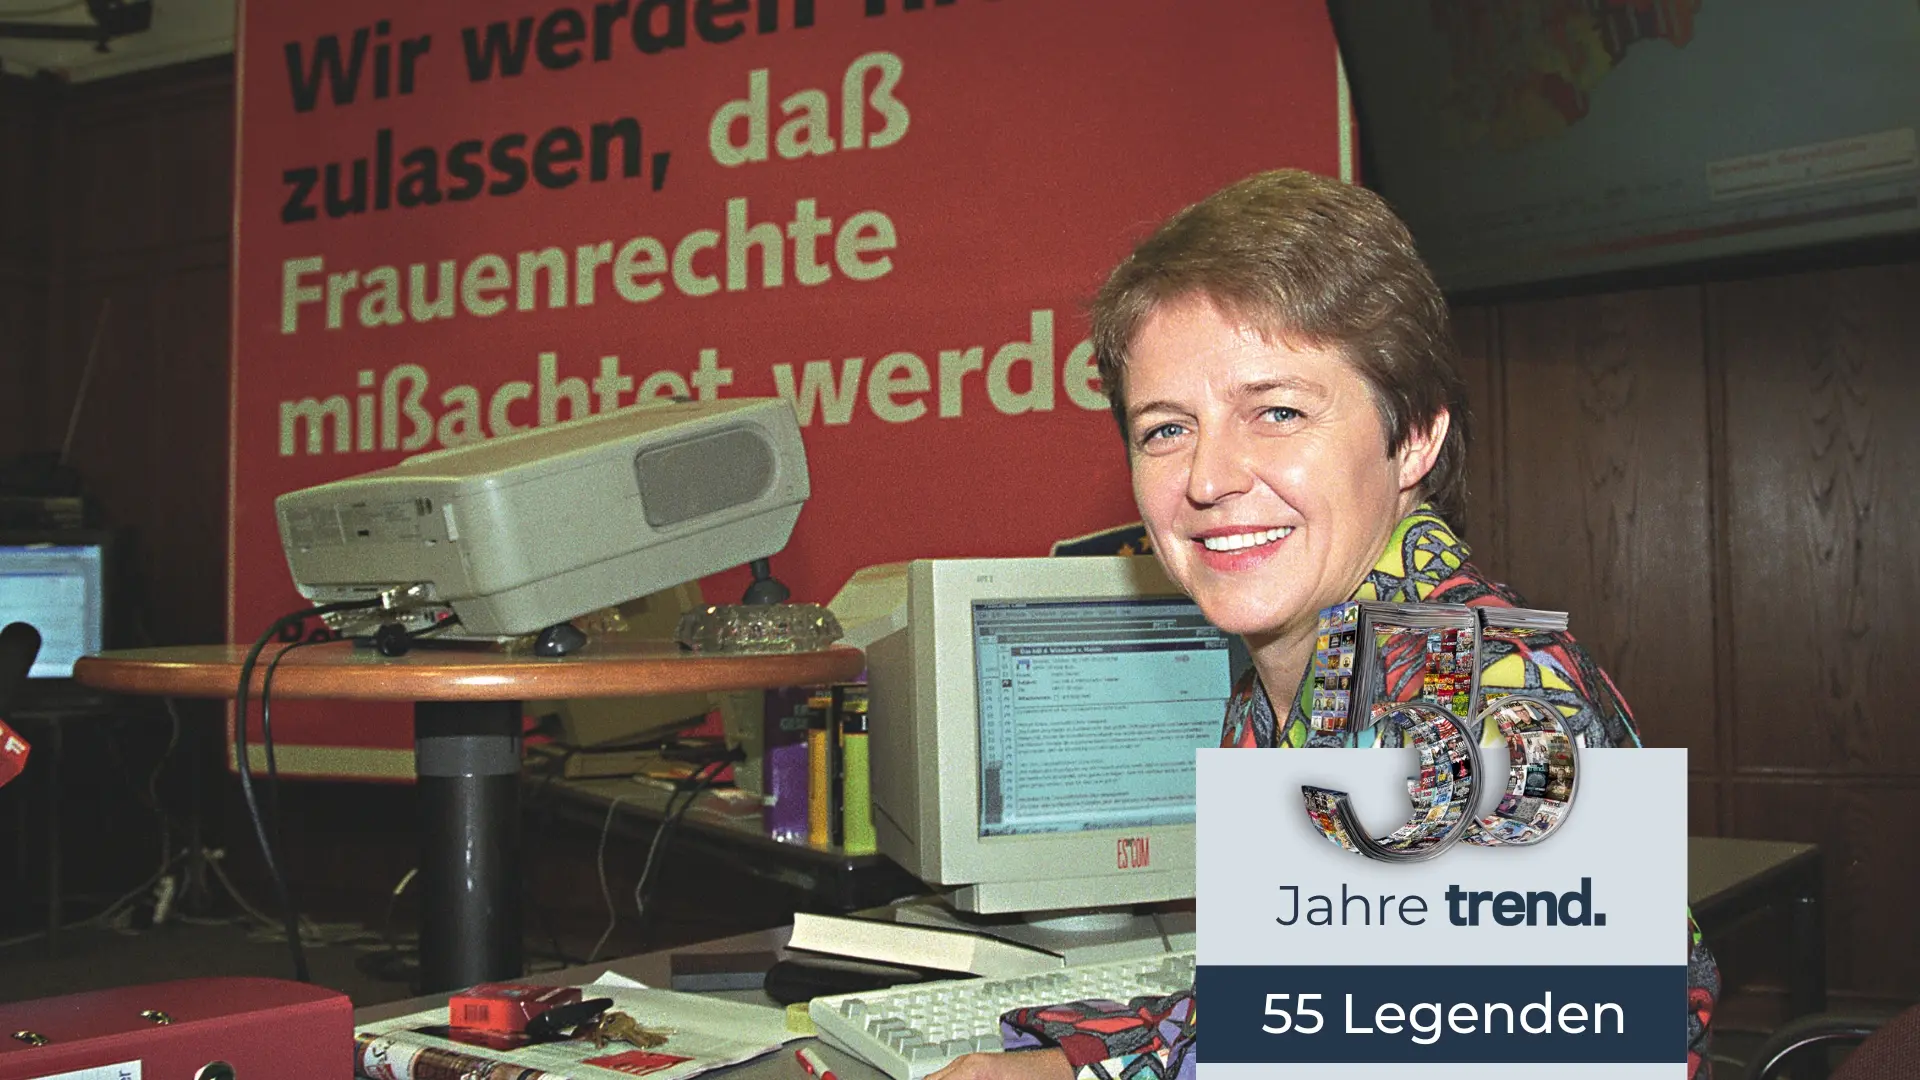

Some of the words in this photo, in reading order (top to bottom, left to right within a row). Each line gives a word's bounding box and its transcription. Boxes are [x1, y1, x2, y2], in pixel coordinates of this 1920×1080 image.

[283, 18, 432, 114] Wir
[281, 117, 671, 224] zulassen,
[708, 51, 910, 167] daß
[281, 197, 898, 335] Frauenrechte
[279, 348, 734, 456] mißachtet
[773, 309, 1112, 426] werde
